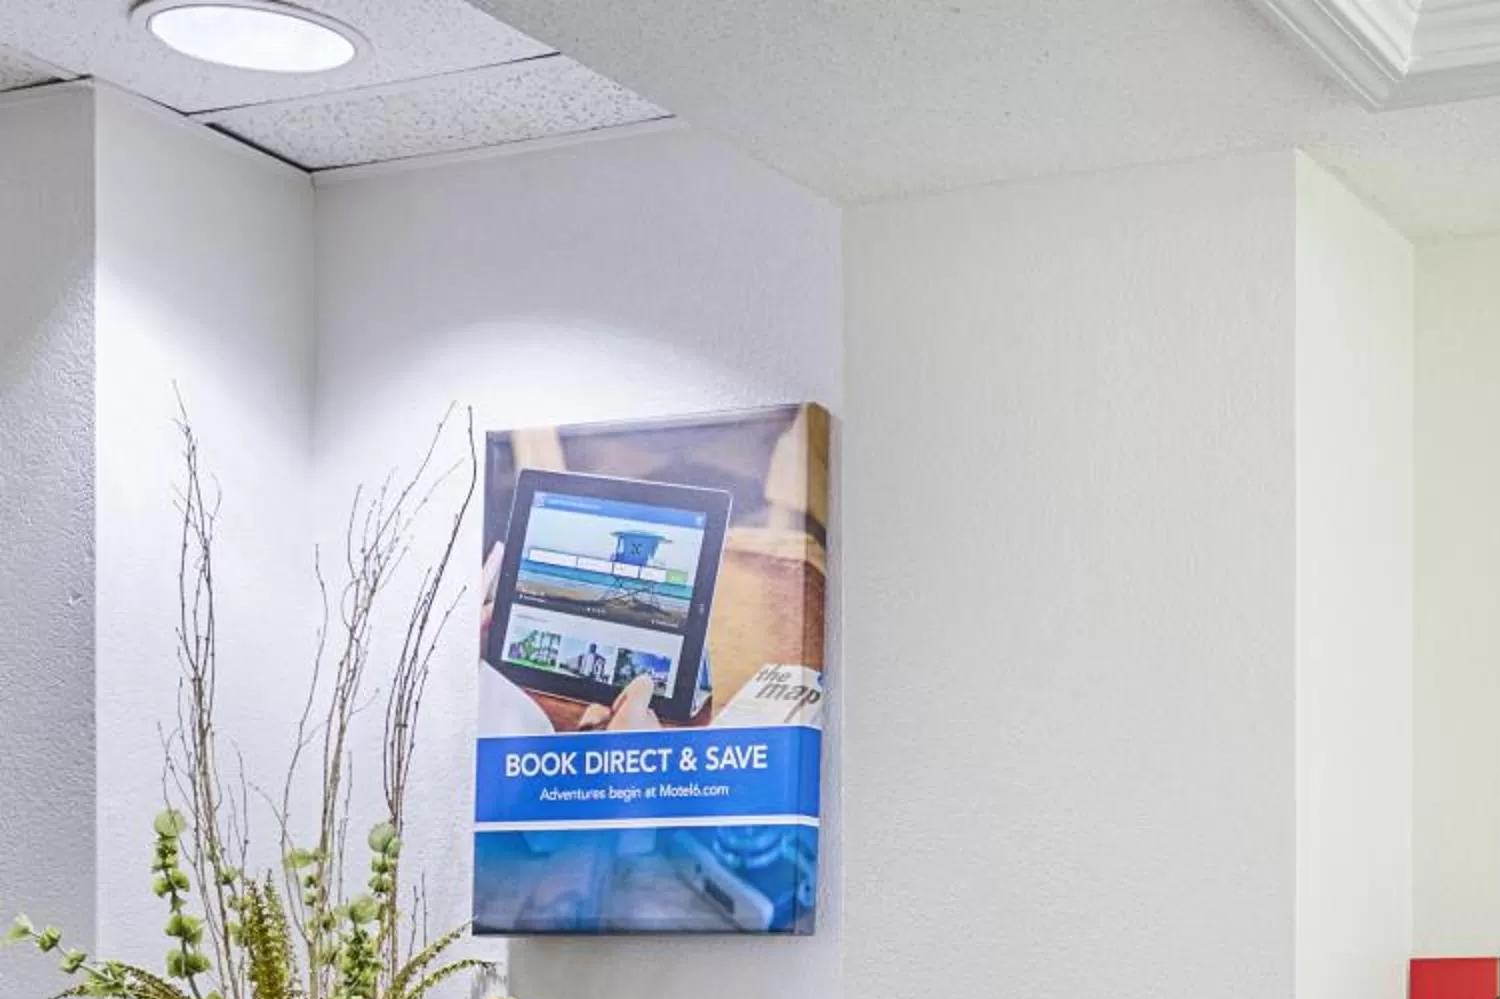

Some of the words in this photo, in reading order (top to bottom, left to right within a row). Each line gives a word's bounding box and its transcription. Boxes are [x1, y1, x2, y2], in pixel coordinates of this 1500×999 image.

[756, 664, 792, 682] the
[755, 684, 821, 723] map
[505, 751, 578, 777] BOOK
[585, 748, 672, 775] DIRECT
[679, 747, 698, 772] &
[705, 744, 769, 771] SAVE
[539, 785, 606, 802] Adventures
[609, 784, 641, 803] begin
[645, 785, 656, 799] at
[660, 781, 730, 799] Motel6.com
